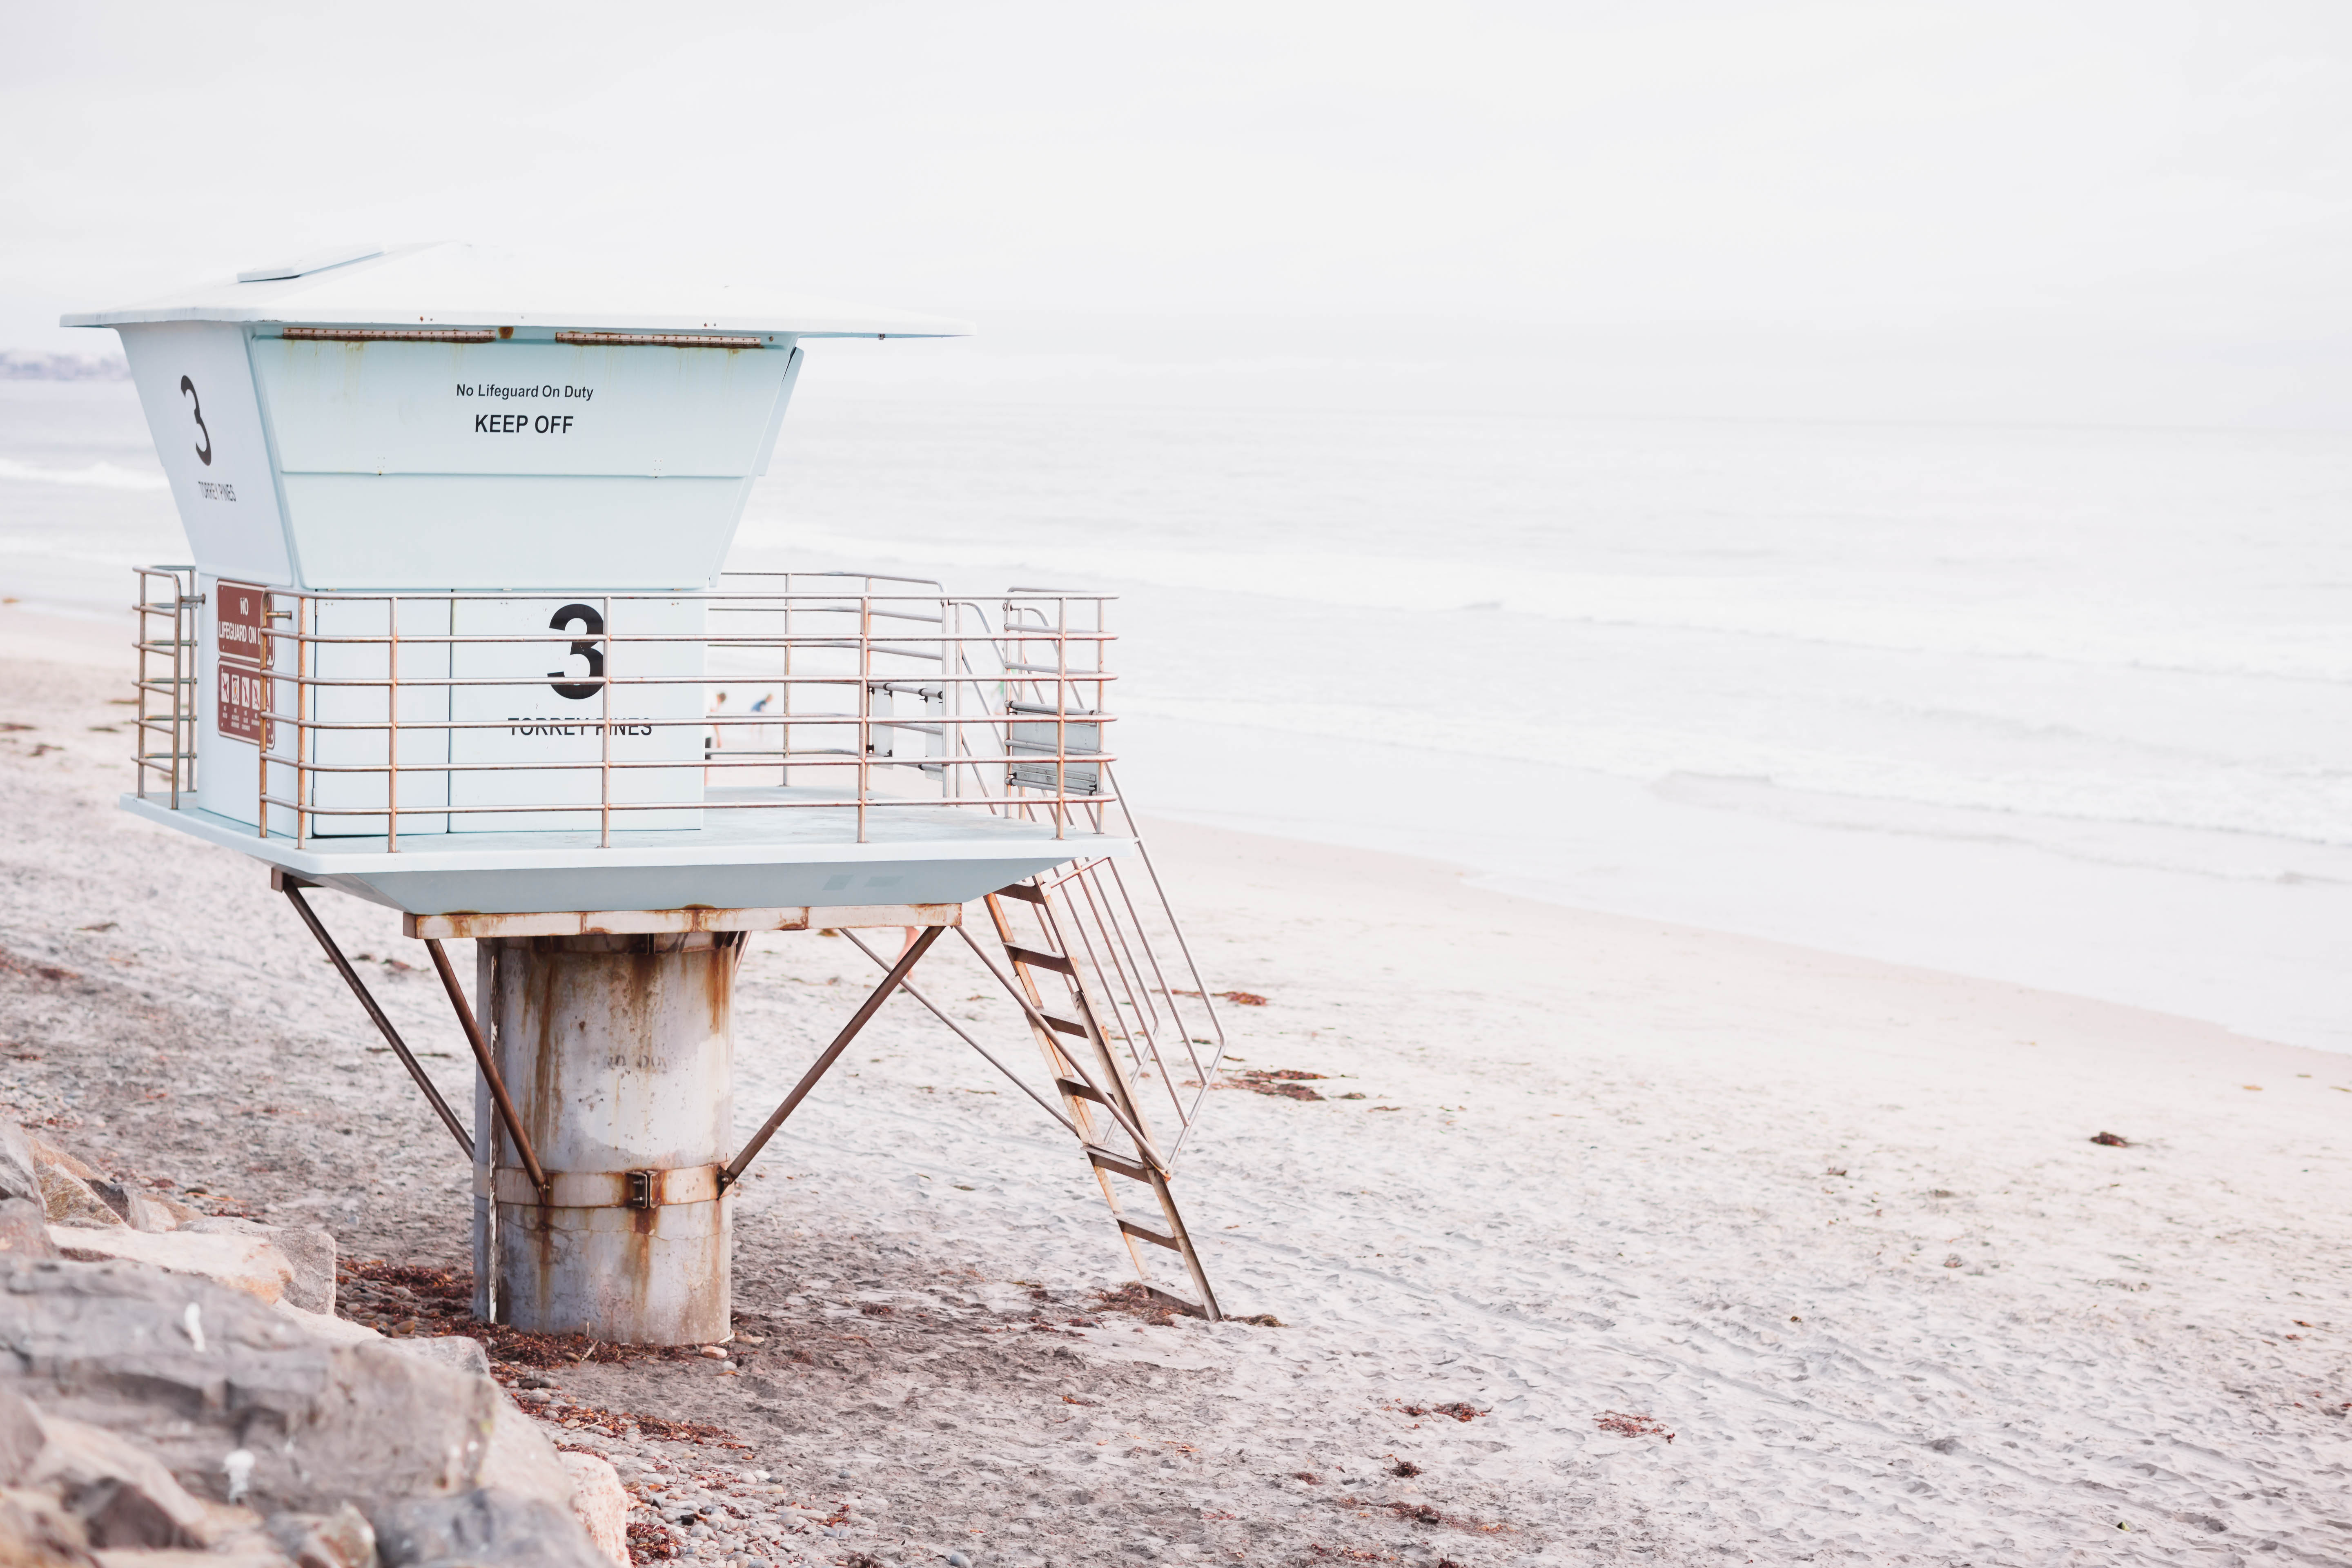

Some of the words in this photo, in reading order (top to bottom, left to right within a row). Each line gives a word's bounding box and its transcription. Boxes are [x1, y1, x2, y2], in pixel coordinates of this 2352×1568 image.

[457, 384, 474, 396] No
[478, 384, 539, 400] Lifeguard
[542, 385, 560, 397] On
[565, 385, 594, 401] Duty
[181, 375, 212, 466] 3
[475, 414, 528, 433] KEEP
[535, 415, 574, 434] OFF
[218, 483, 236, 502] PINES
[240, 597, 249, 616] NO
[219, 620, 247, 642] LIFEGUARD
[248, 625, 256, 644] ON
[547, 604, 604, 700] 3
[508, 717, 589, 735] TORREY
